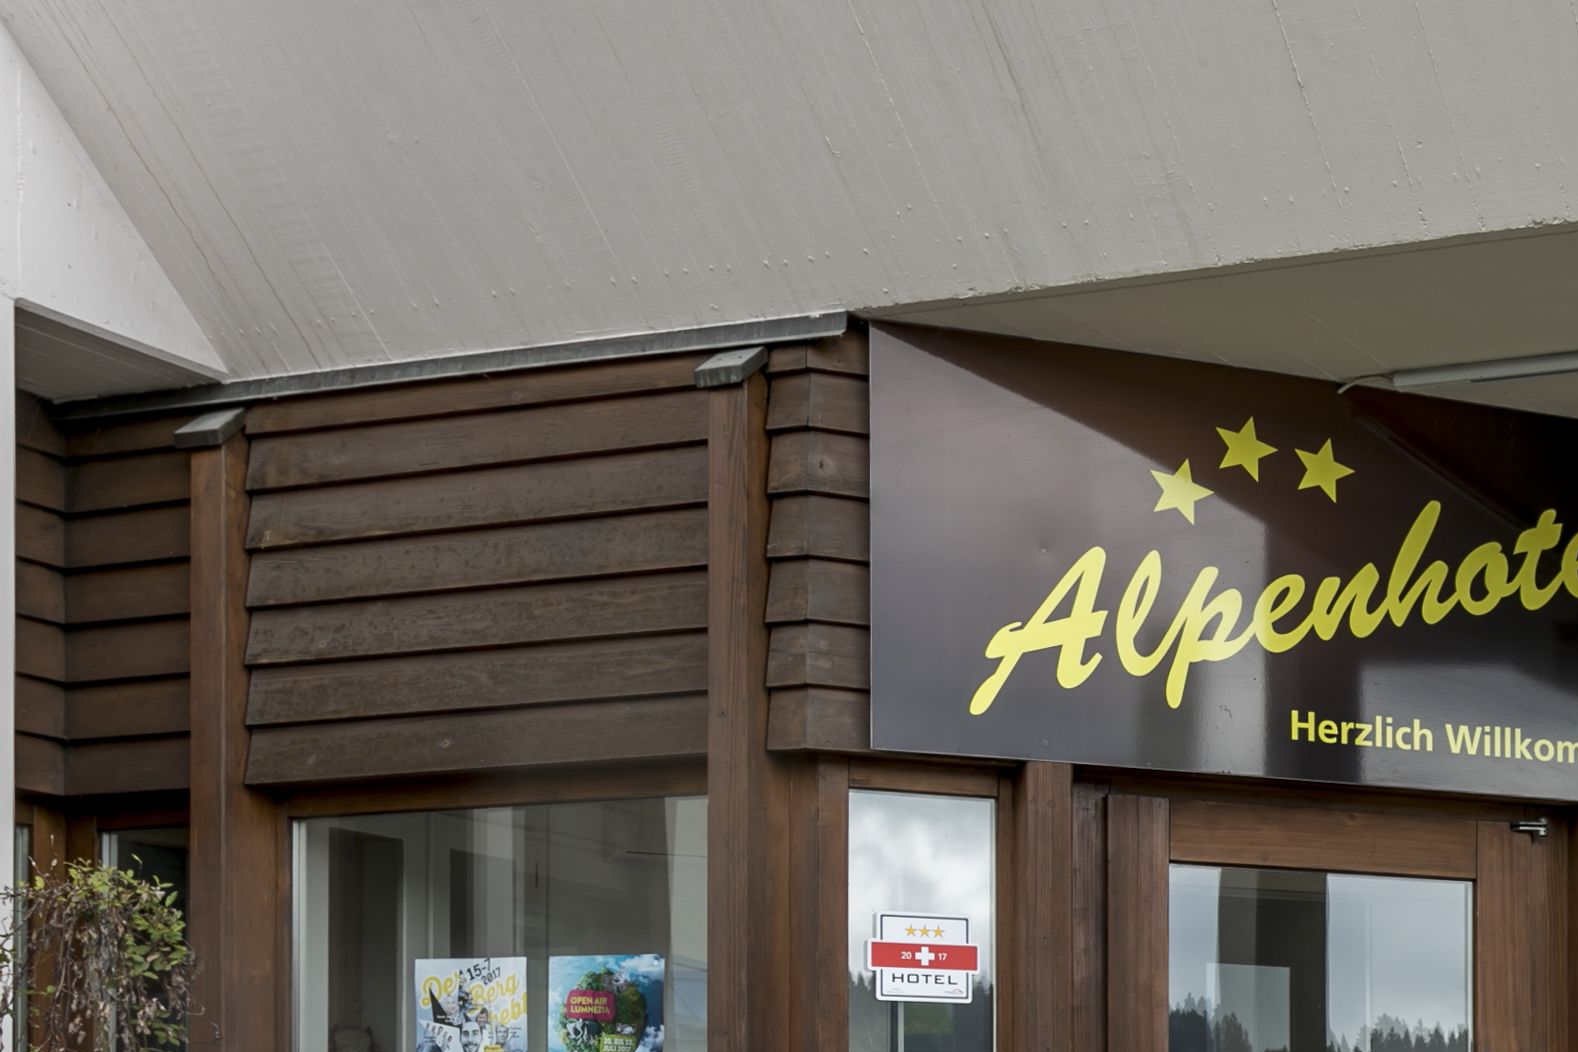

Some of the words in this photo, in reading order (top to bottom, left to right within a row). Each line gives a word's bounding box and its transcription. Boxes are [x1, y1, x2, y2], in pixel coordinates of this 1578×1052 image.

[1290, 709, 1433, 752] Herzlich
[901, 951, 912, 960] 20
[938, 952, 947, 961] 17
[481, 966, 501, 985] 2017
[892, 973, 958, 985] HOTEL
[571, 996, 593, 1005] OPEN
[594, 997, 608, 1005] AIR
[571, 1005, 610, 1014] LUMNEZIA
